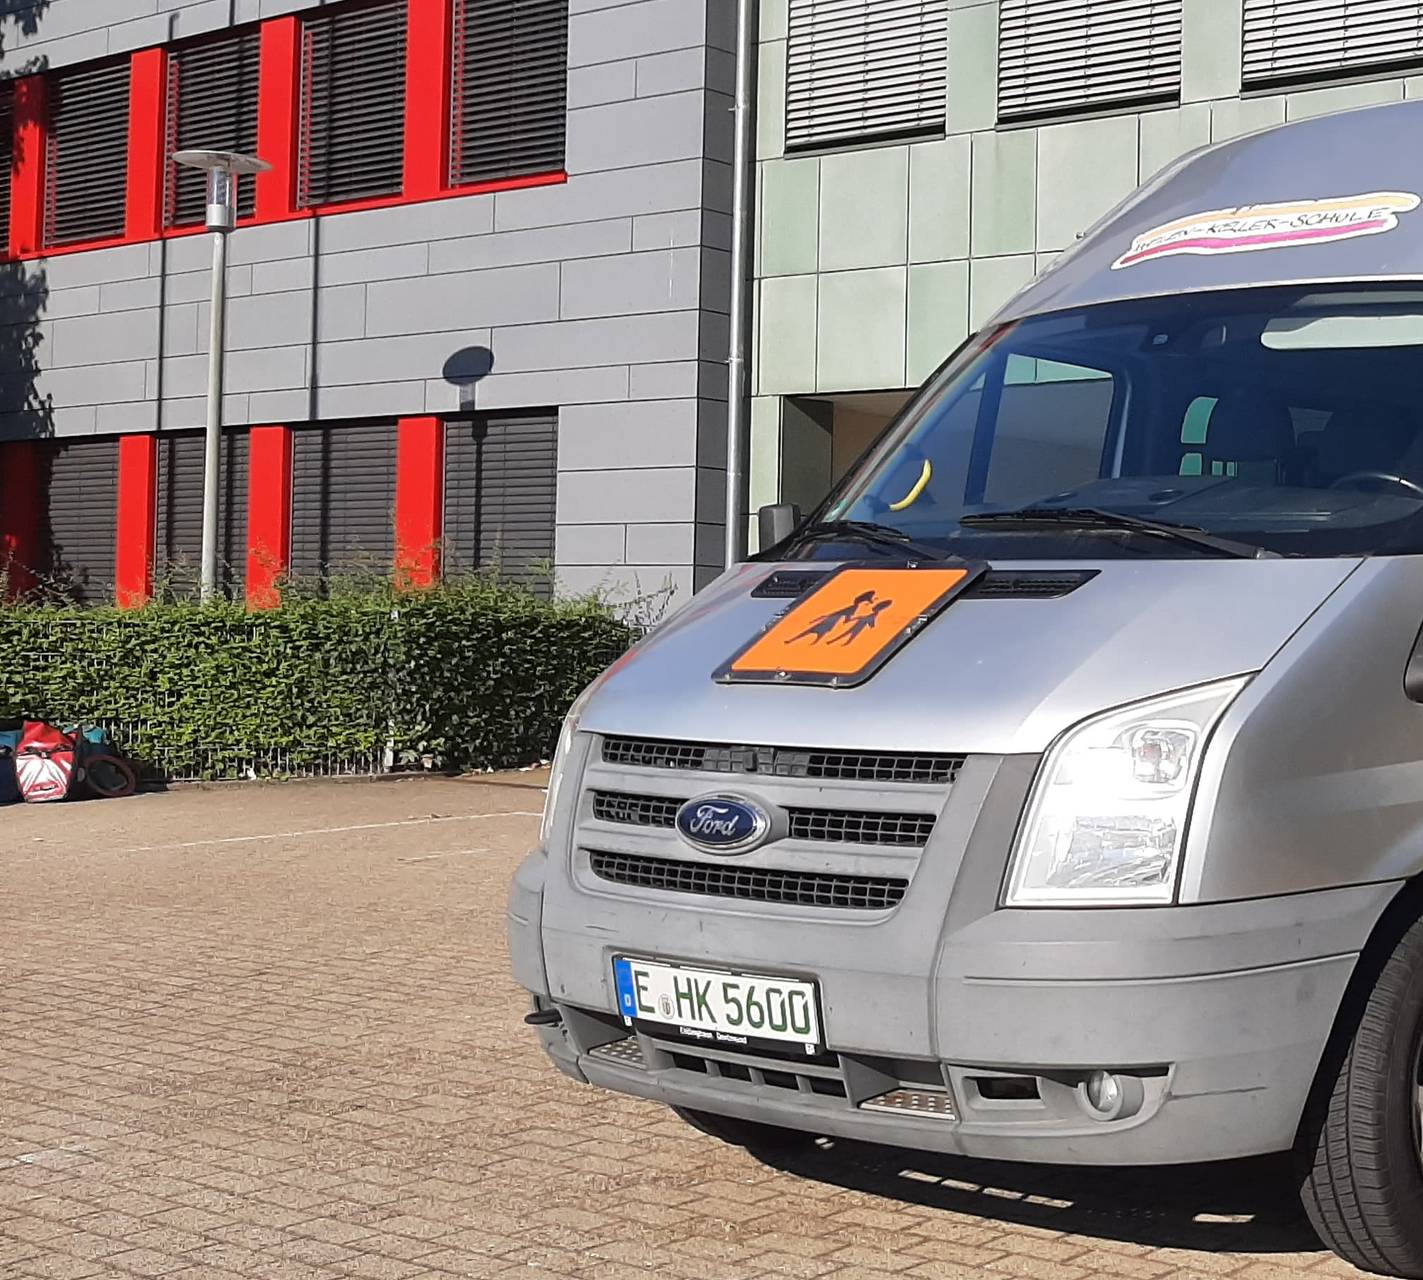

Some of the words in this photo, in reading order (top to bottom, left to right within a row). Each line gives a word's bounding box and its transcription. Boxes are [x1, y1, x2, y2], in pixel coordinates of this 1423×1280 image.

[690, 805, 739, 837] Ford
[634, 970, 656, 1013] E
[673, 975, 718, 1023] HK
[722, 982, 810, 1034] 5600
